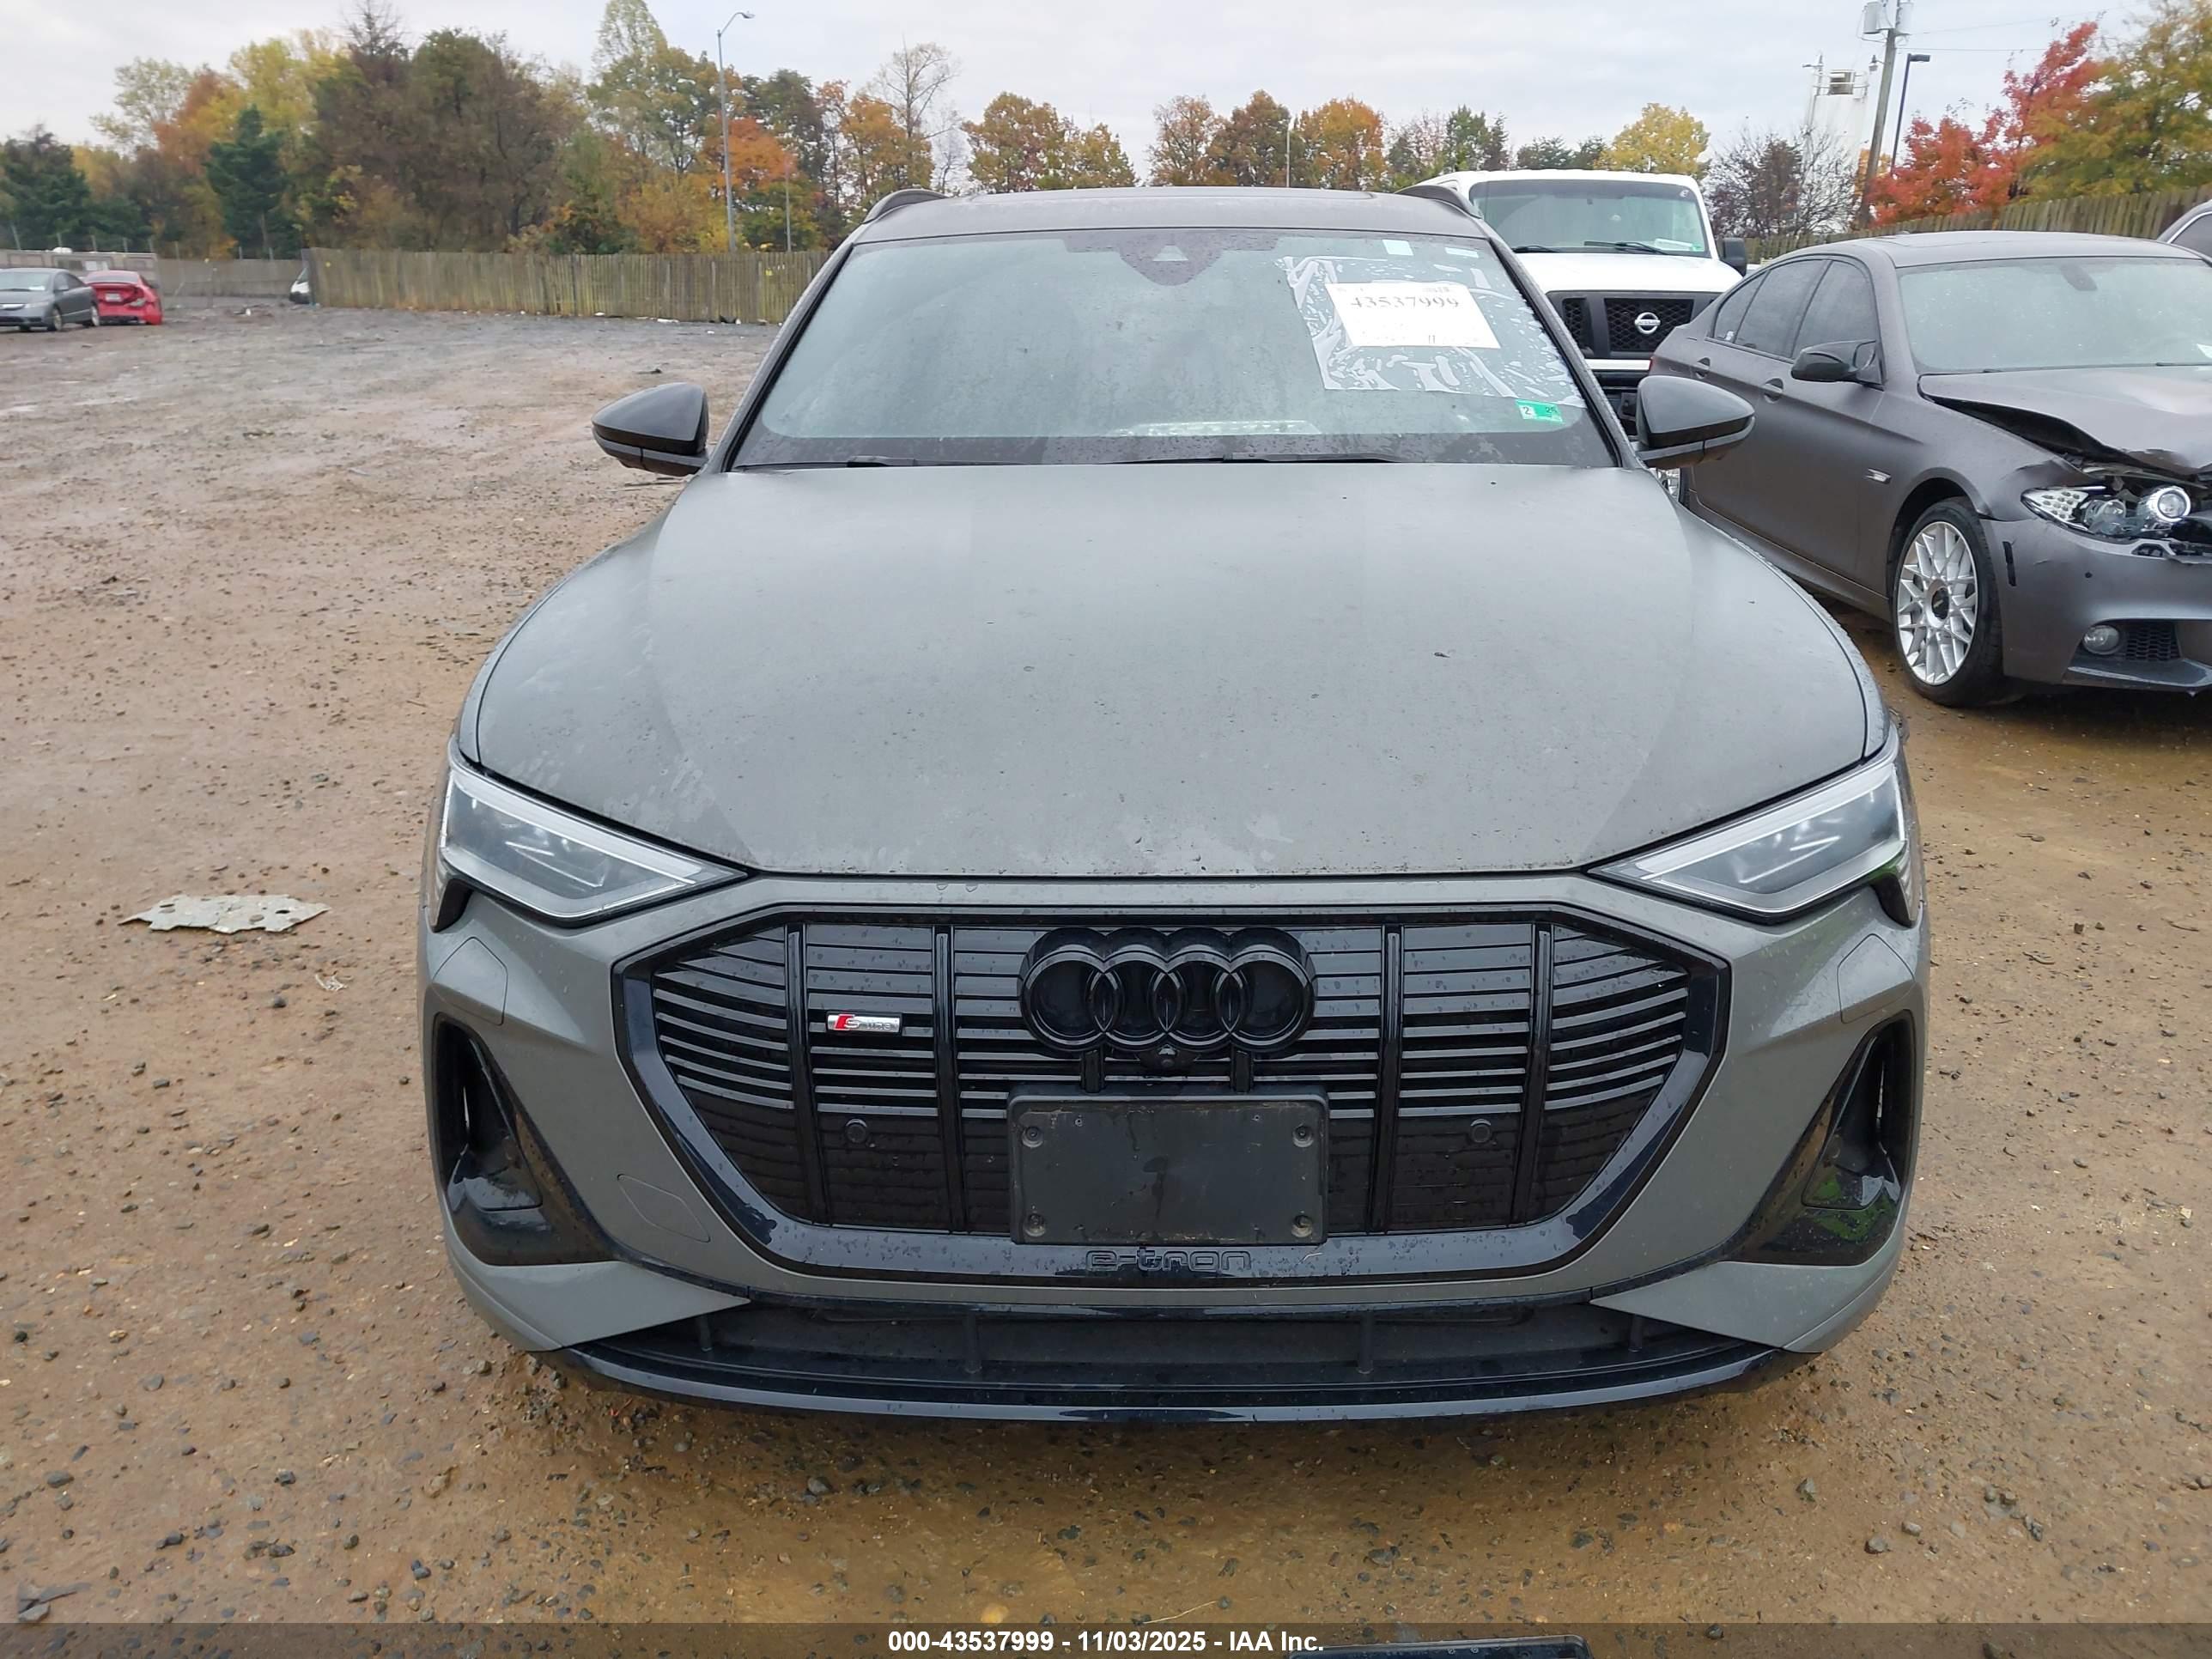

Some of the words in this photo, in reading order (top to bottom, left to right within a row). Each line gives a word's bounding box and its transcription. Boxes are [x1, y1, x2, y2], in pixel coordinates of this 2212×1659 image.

[1350, 296, 1460, 308] 43537999
[1522, 406, 1533, 415] 2
[1085, 1246, 1252, 1272] e-tron
